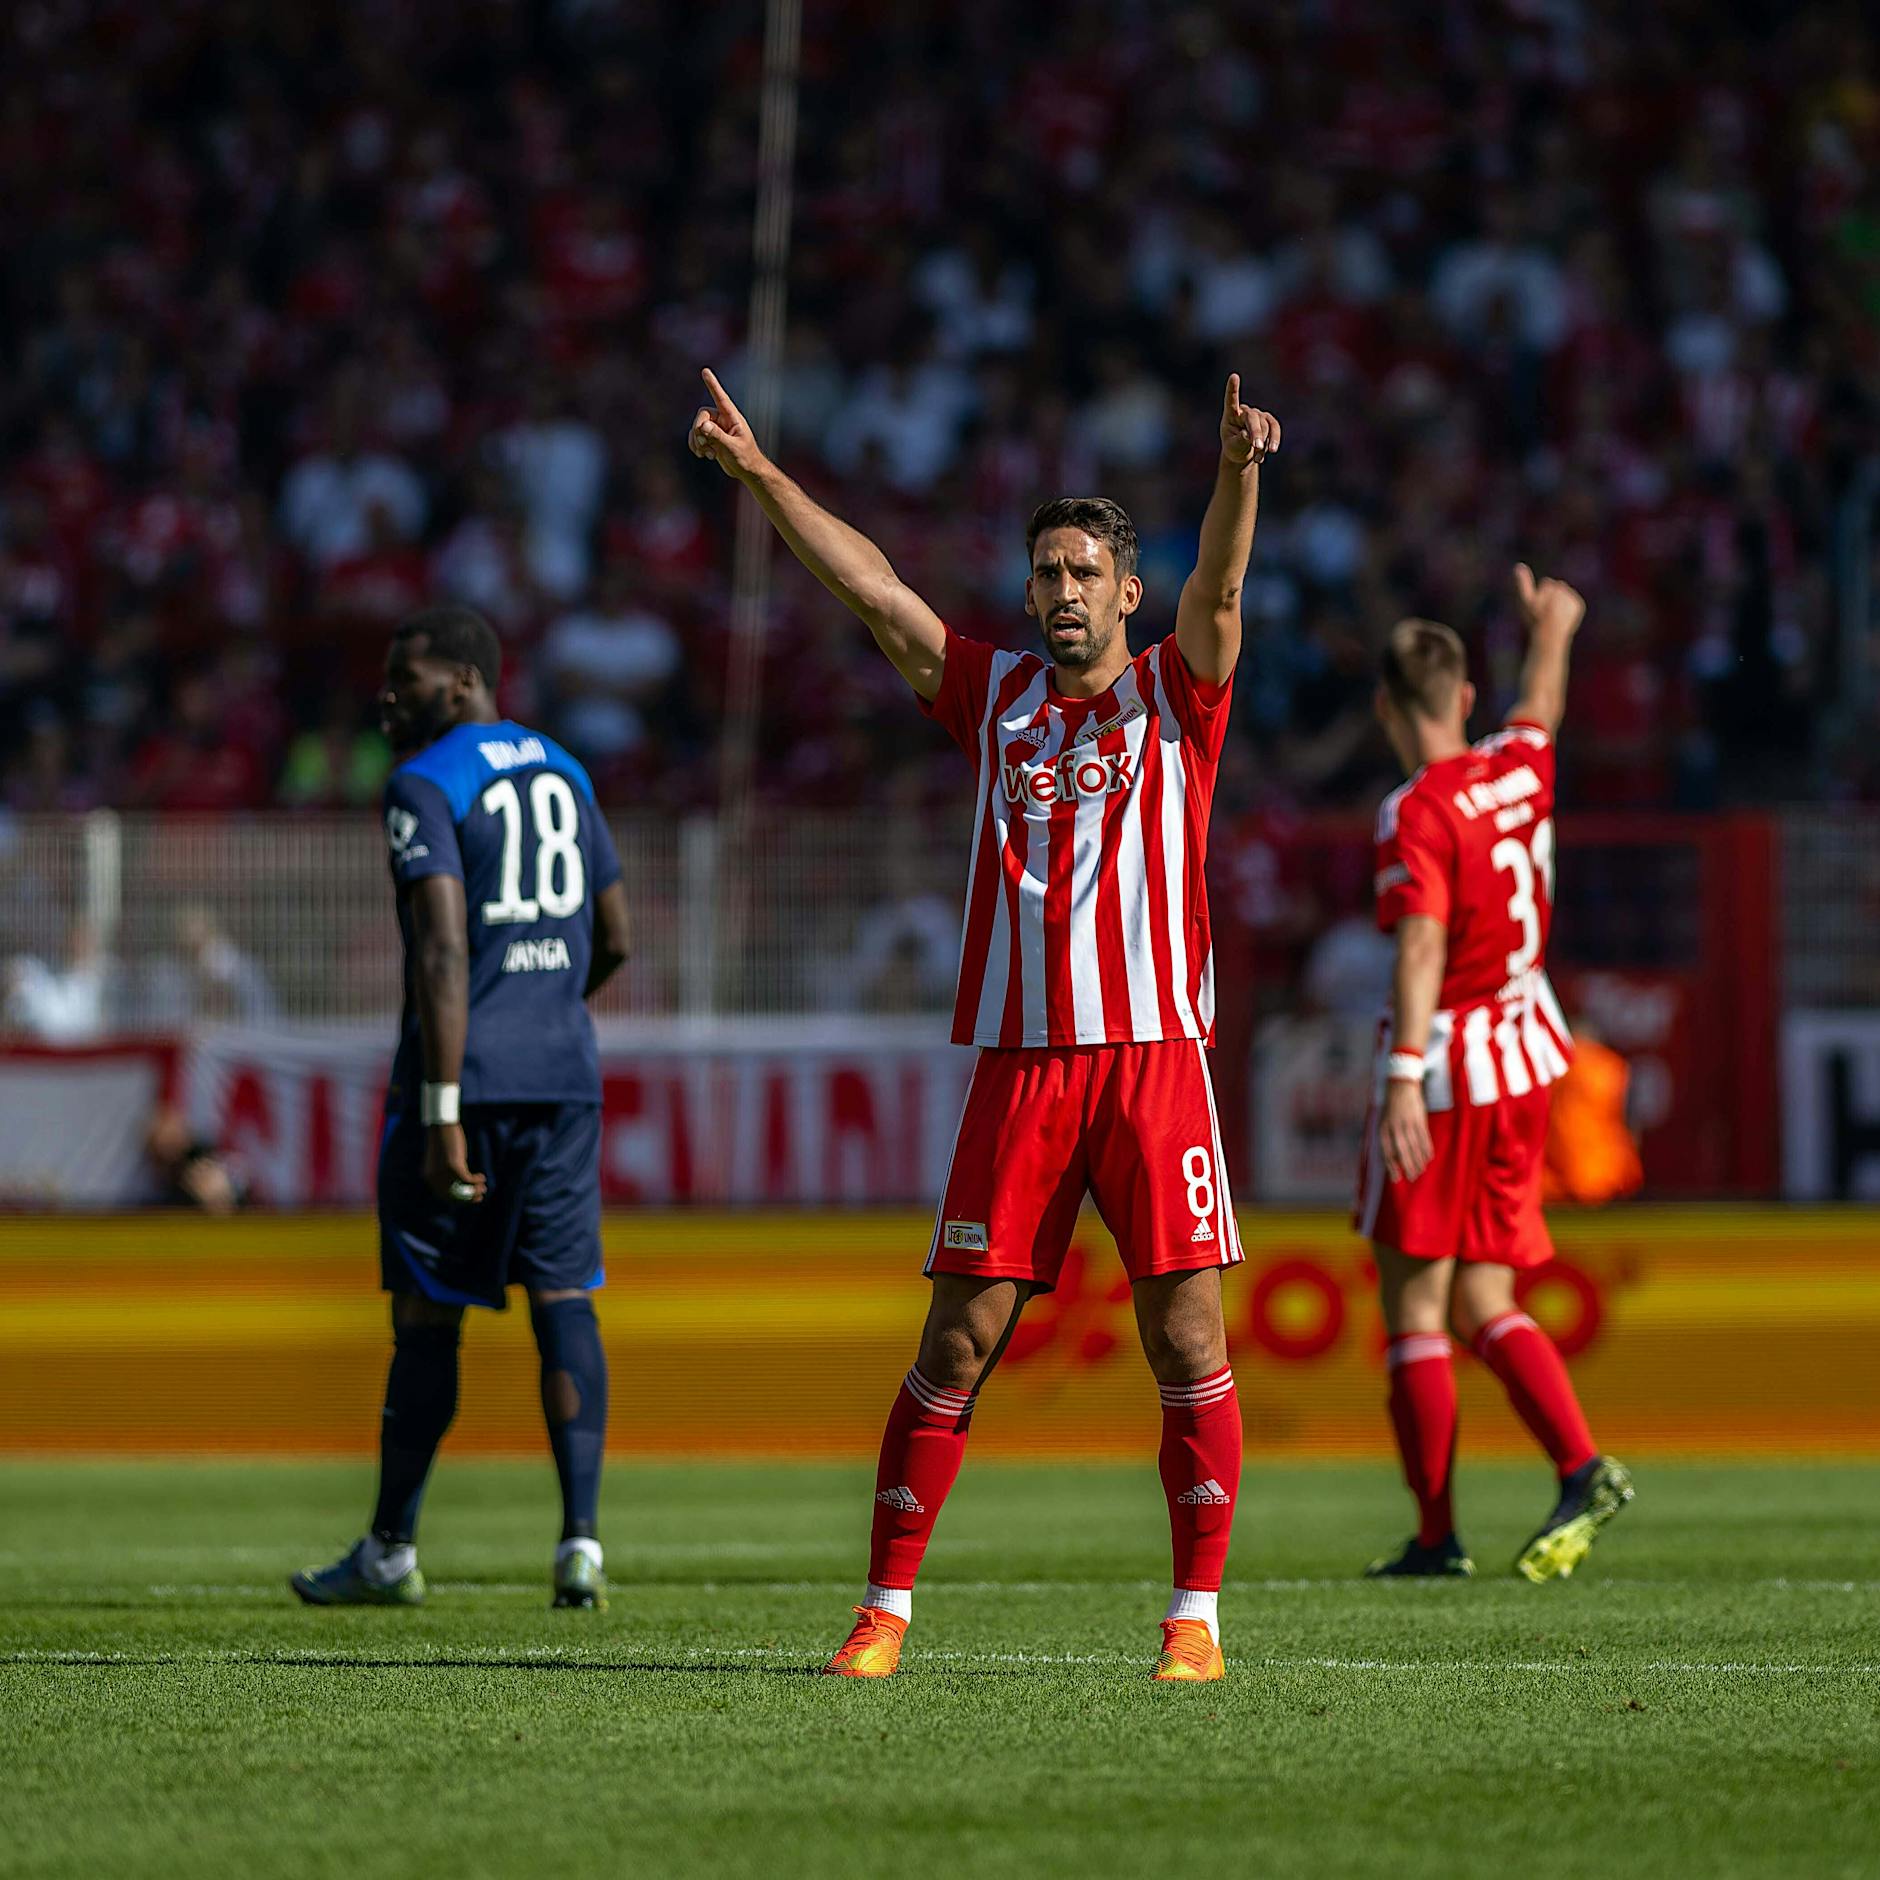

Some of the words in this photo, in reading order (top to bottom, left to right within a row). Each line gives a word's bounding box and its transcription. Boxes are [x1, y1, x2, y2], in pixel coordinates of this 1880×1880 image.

[1016, 731, 1046, 750] adidas
[1003, 751, 1135, 803] wefox
[482, 771, 585, 926] 18
[1181, 1145, 1215, 1218] 8
[1191, 1231, 1215, 1242] adidas
[876, 1493, 925, 1513] adidas
[1177, 1494, 1231, 1504] adidas
